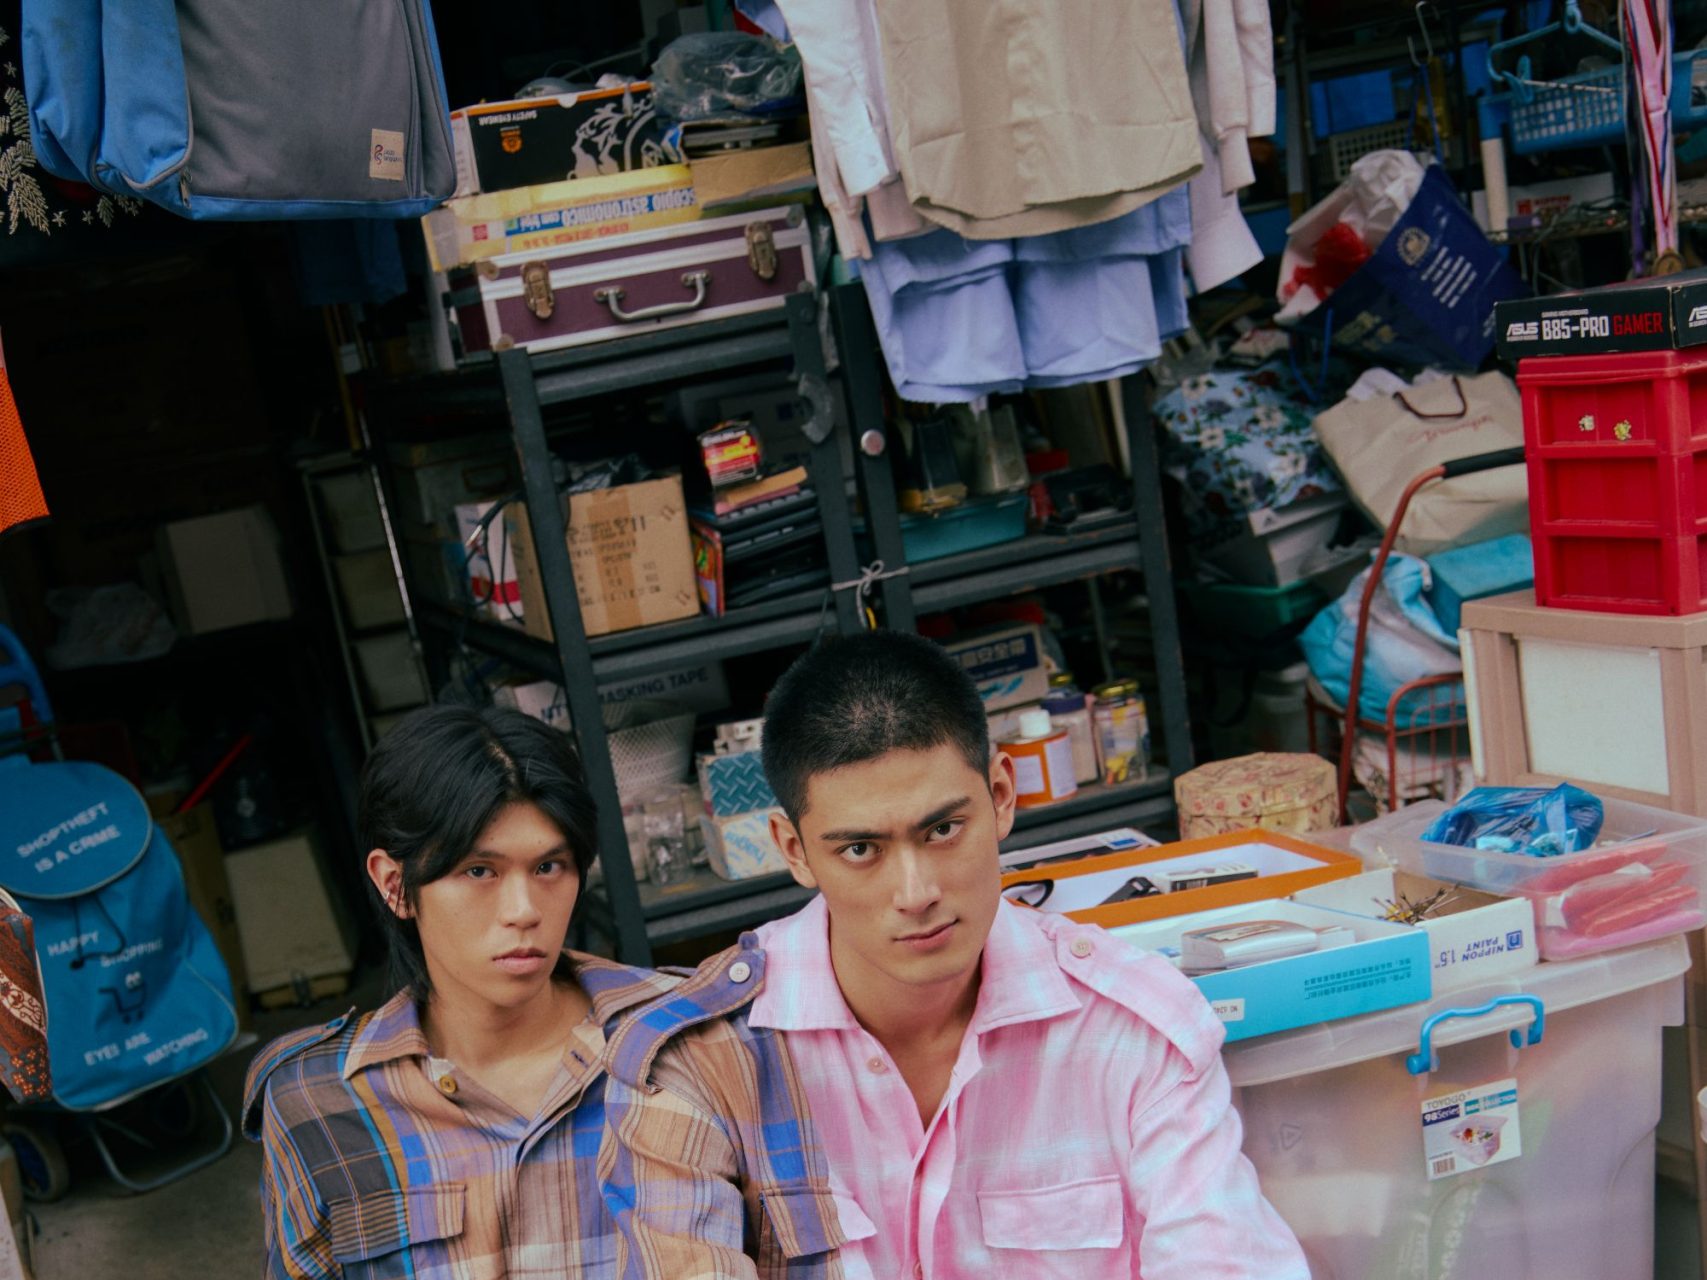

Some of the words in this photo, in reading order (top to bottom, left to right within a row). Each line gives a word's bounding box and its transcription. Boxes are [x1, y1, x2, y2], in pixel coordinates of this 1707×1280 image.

[479, 111, 512, 126] EYEWEAR
[513, 109, 538, 122] SAFETY
[1506, 322, 1539, 336] ASUS
[1542, 316, 1609, 340] B85-PRO
[1613, 312, 1663, 337] GAMER
[669, 666, 708, 690] TAPE
[16, 801, 109, 858] SHOPTHEFT
[34, 857, 54, 873] IS
[55, 850, 70, 863] A
[69, 824, 121, 855] CRIME
[47, 931, 99, 956] HAPPY
[1461, 945, 1504, 962] NIPPON
[1466, 936, 1499, 952] PAINT
[125, 1031, 151, 1051] ARE
[143, 1028, 209, 1066] WATCHING
